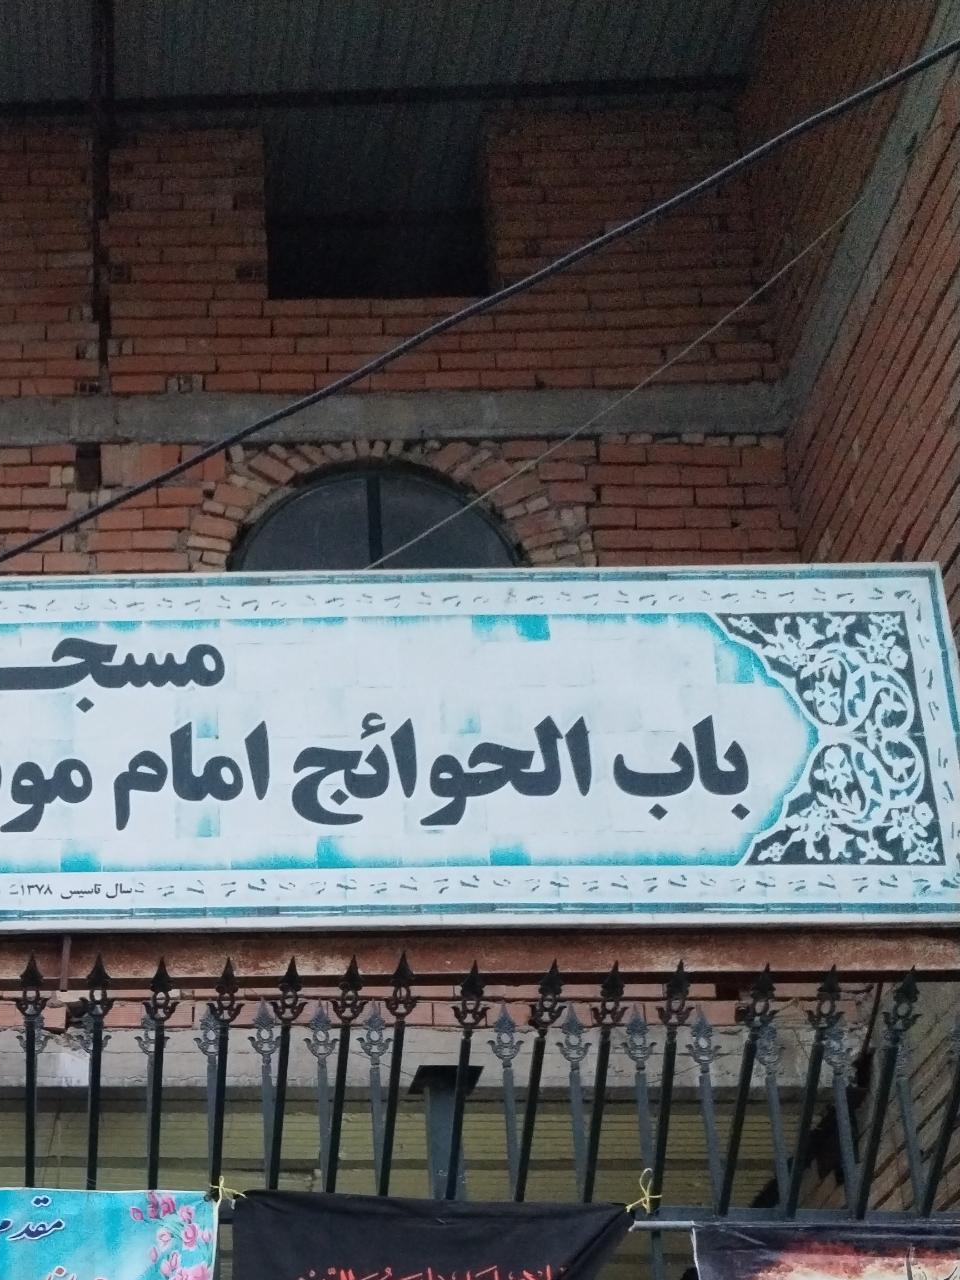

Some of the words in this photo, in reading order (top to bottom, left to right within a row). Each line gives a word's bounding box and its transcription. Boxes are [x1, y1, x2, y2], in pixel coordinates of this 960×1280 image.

[114, 720, 270, 831] امام
[291, 711, 592, 826] الحوائج
[613, 715, 750, 820] باب
[60, 883, 102, 900] تاسیس
[105, 883, 133, 899] سال
